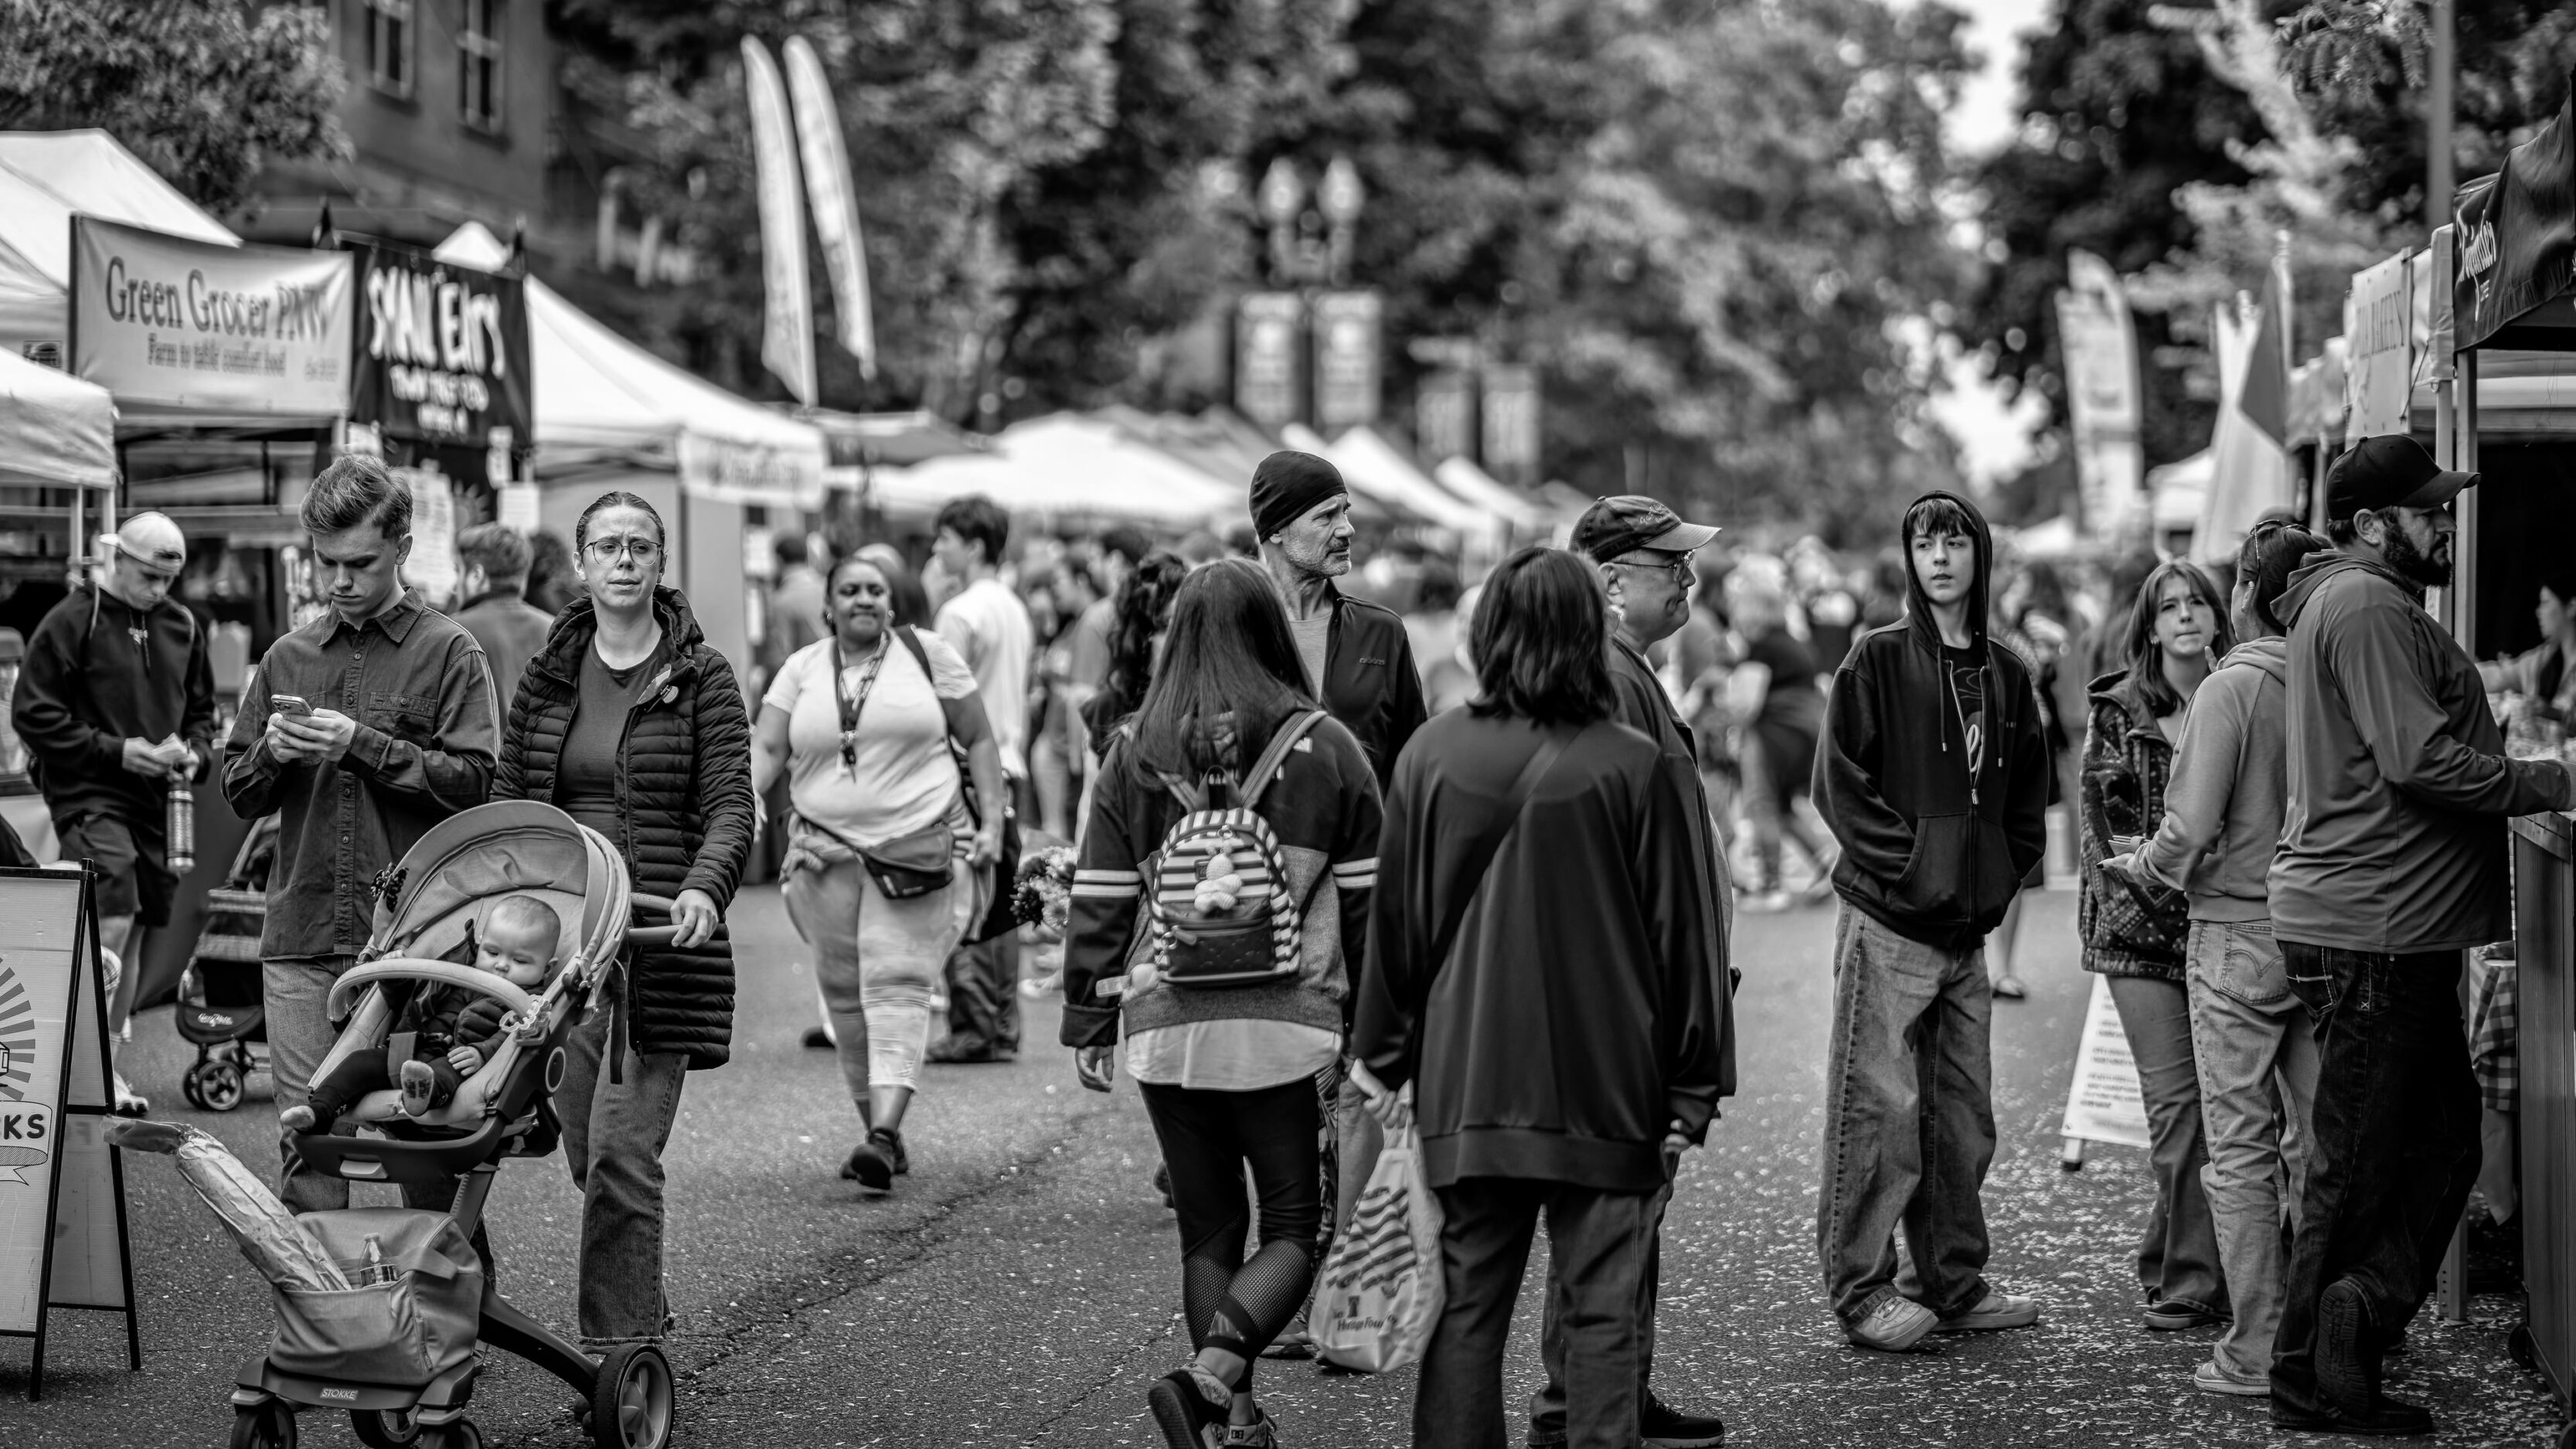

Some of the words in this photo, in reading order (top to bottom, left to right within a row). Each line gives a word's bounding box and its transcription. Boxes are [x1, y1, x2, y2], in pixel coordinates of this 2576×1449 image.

[106, 256, 182, 328] Green
[187, 269, 271, 338] Grocer
[0, 1114, 45, 1140] KS
[322, 1389, 356, 1399] STOKKE
